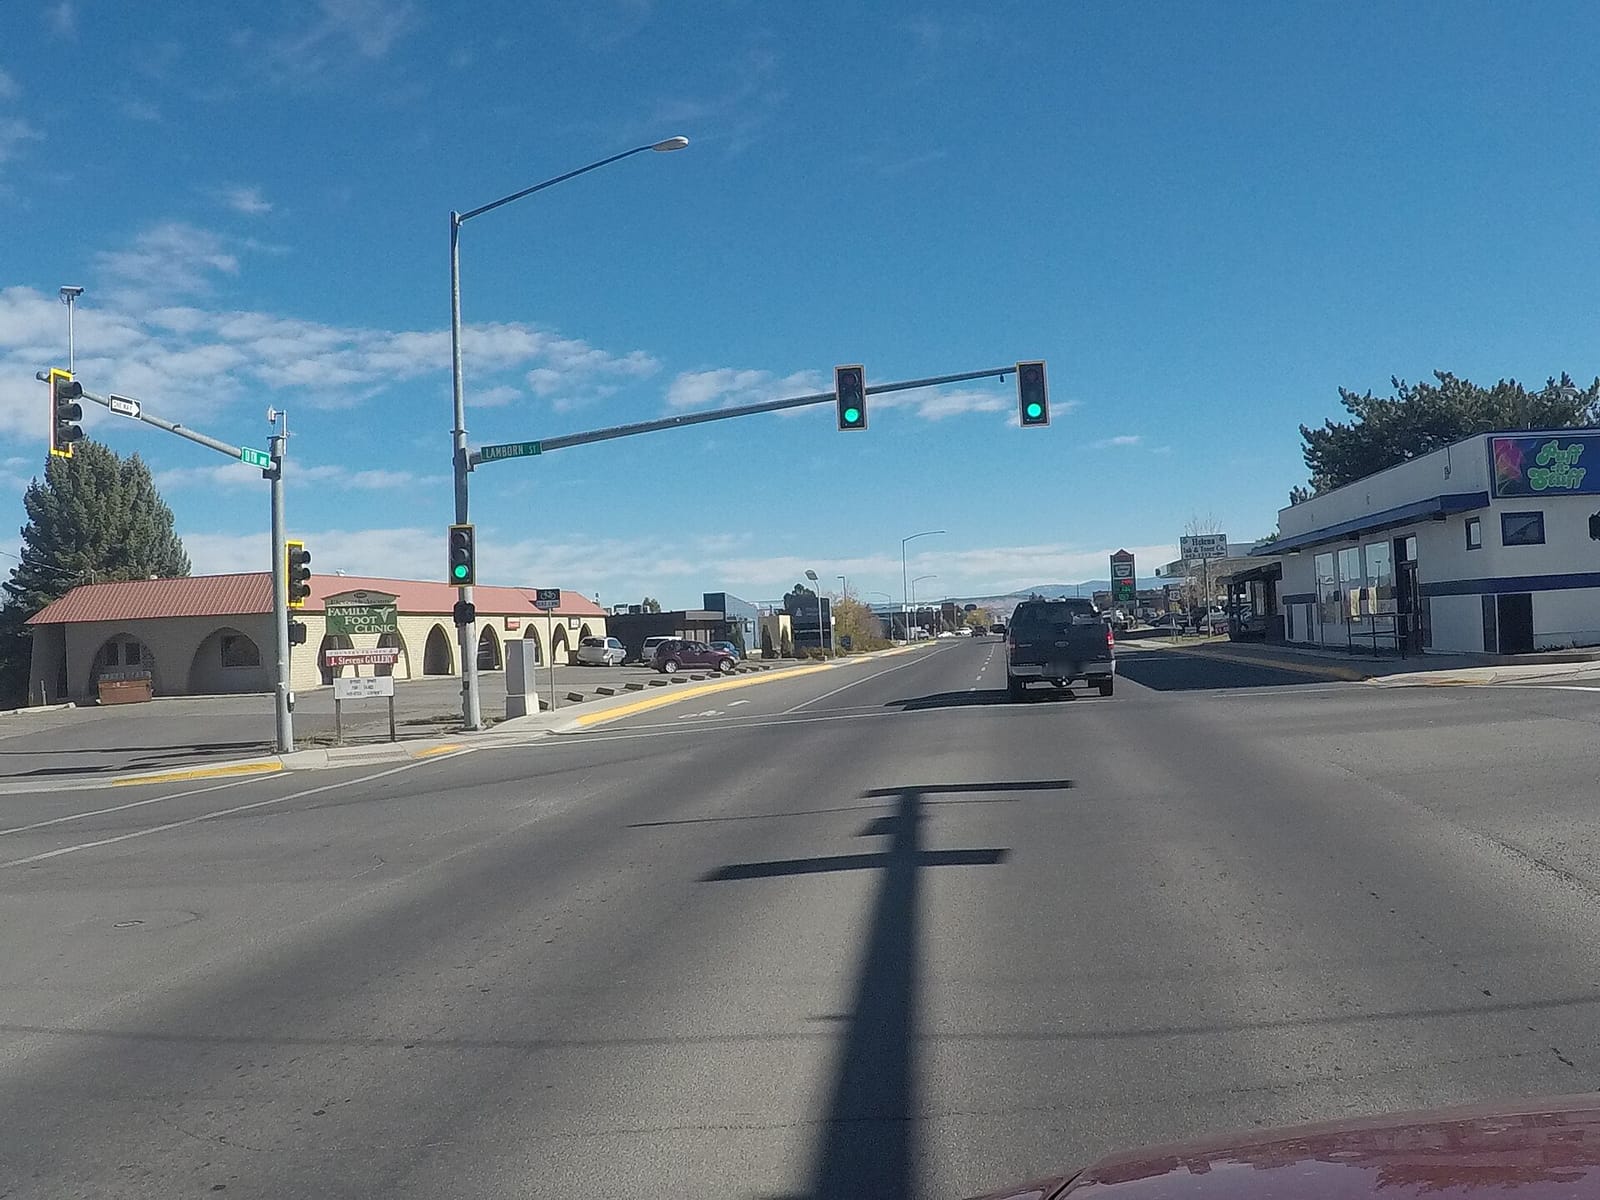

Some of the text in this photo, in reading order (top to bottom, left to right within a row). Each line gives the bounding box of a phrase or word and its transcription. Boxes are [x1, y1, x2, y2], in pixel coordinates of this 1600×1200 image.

[486, 444, 537, 459] LAMBORN ST
[1536, 440, 1584, 465] Puff
[1527, 467, 1586, 490] Stuff
[1191, 537, 1215, 546] Helena
[327, 607, 370, 617] FAMILY
[344, 615, 378, 625] FOOT
[354, 624, 396, 634] CLINIC
[338, 655, 365, 666] Stevens
[365, 654, 394, 664] GALLERY
